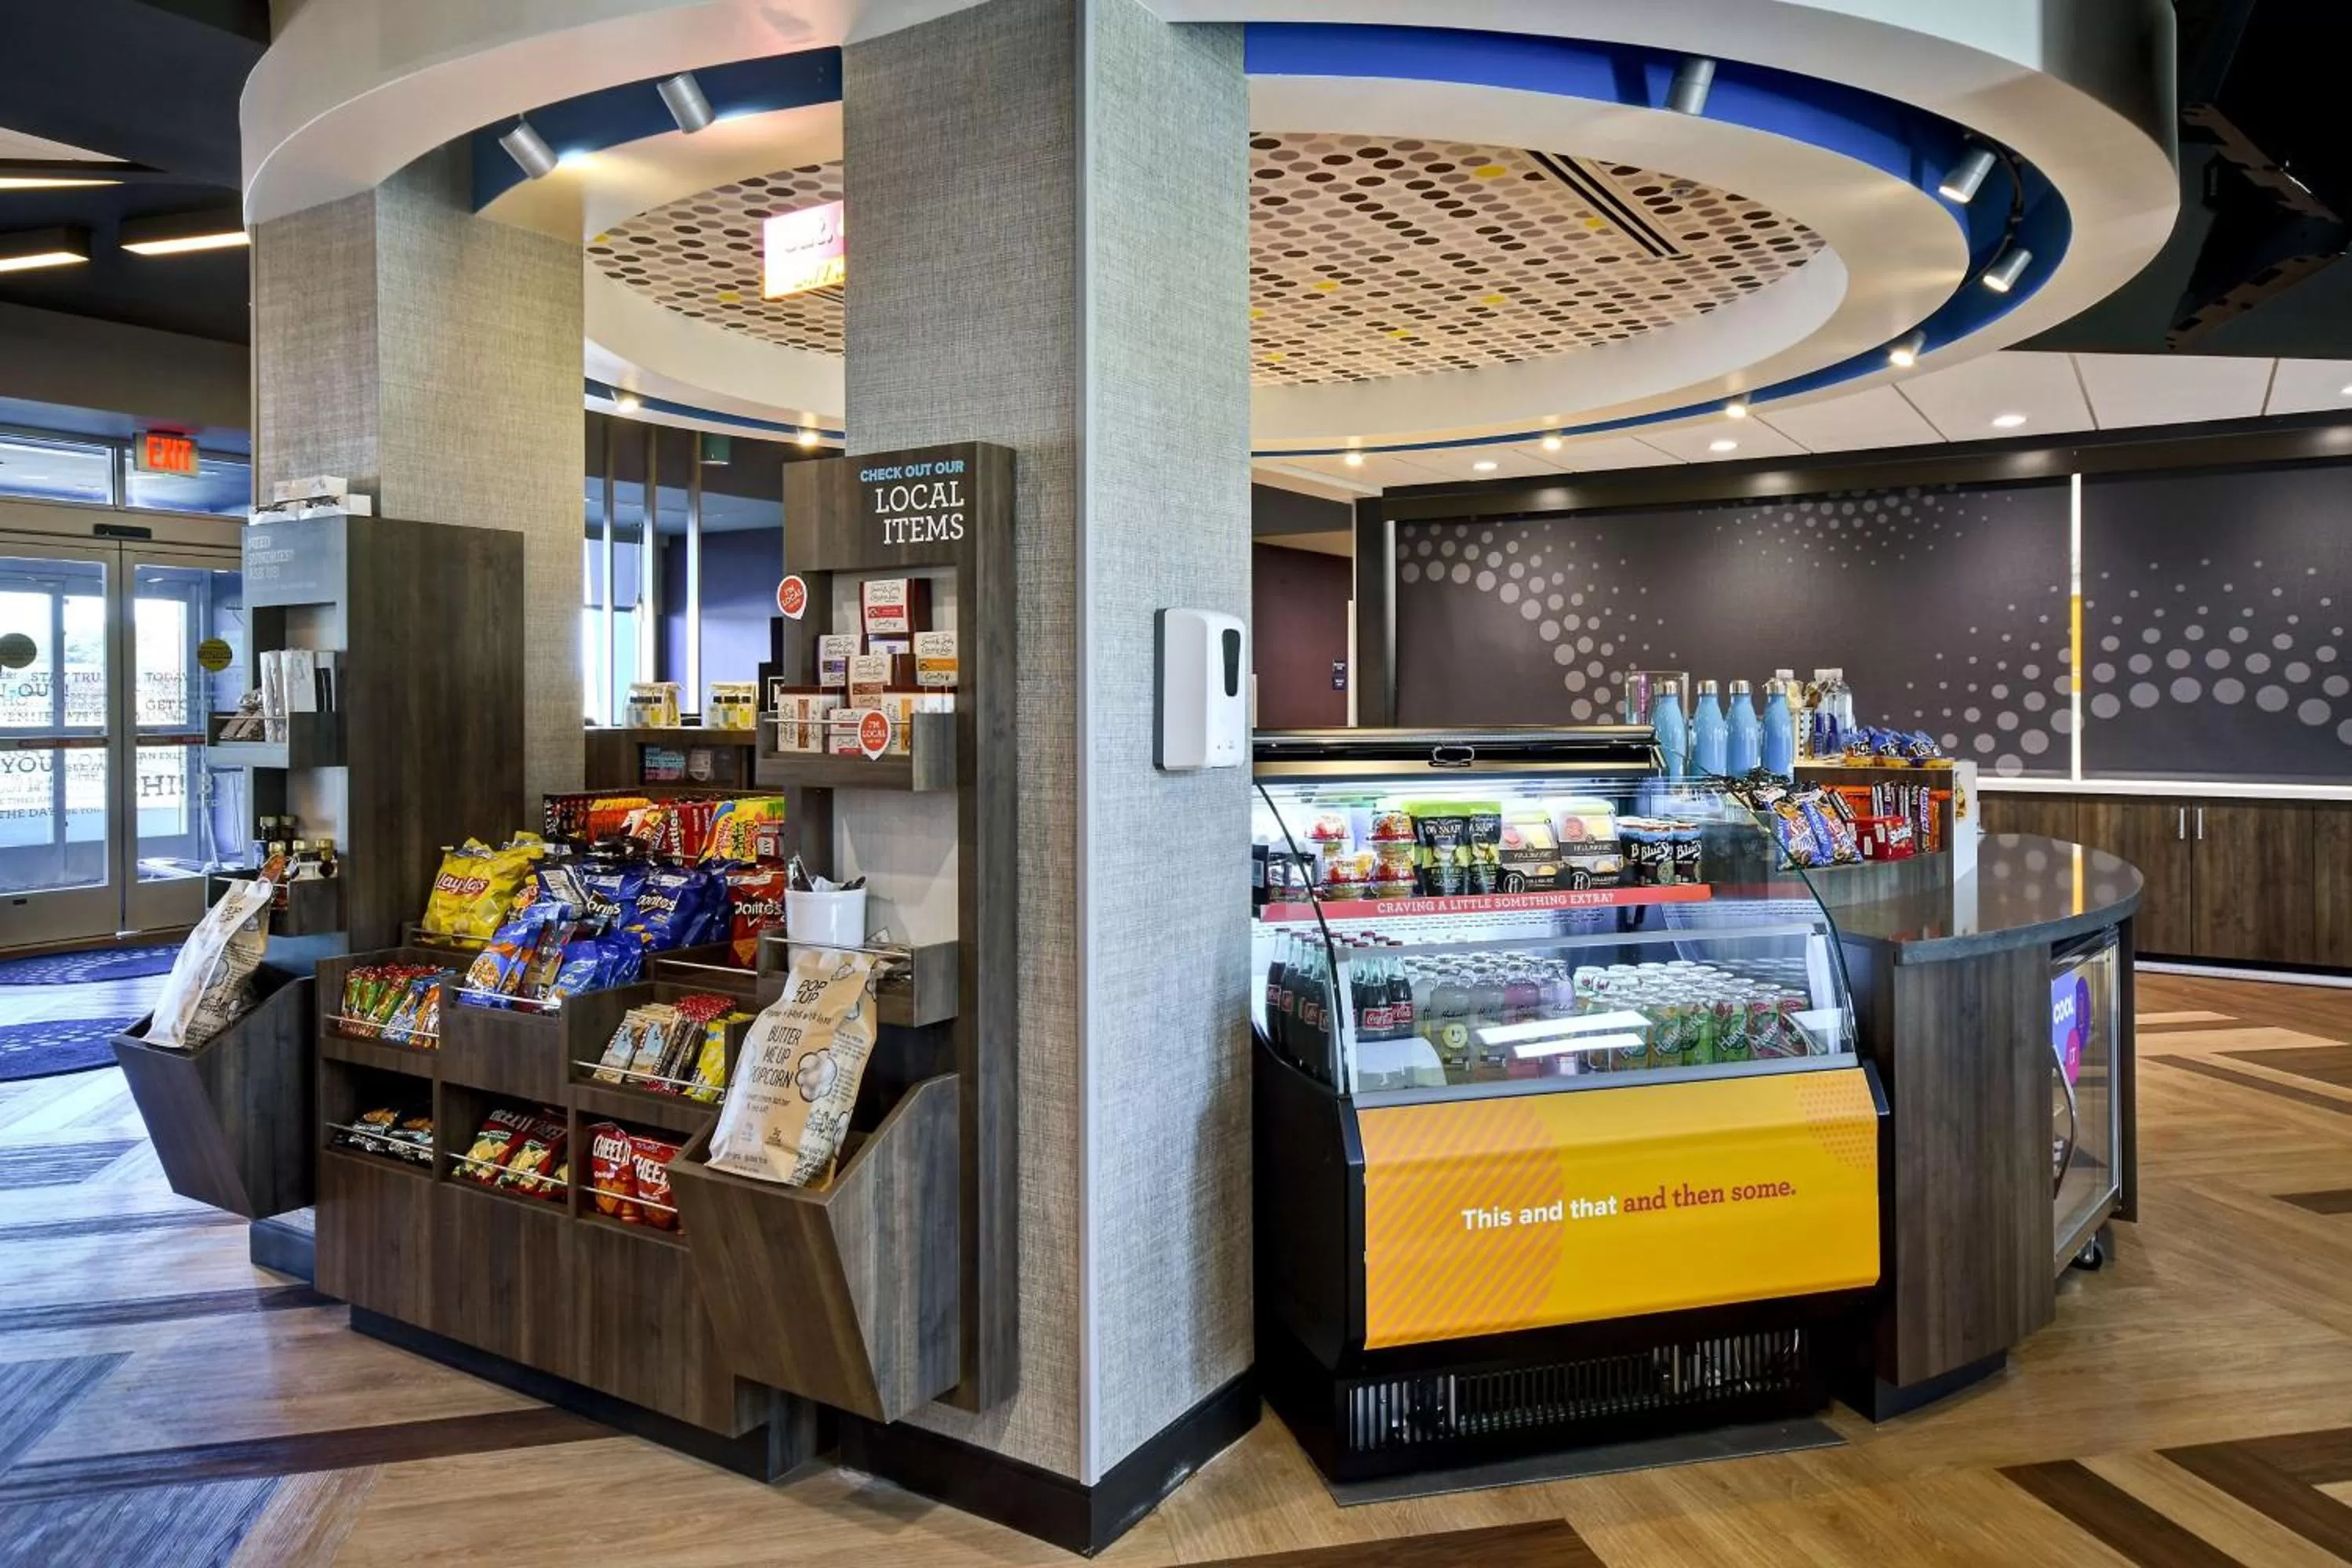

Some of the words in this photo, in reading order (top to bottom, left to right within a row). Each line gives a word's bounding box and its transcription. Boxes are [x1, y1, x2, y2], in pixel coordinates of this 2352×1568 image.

[147, 436, 191, 472] EXIT
[860, 466, 902, 482] CHECK
[906, 463, 932, 477] OUT
[935, 460, 964, 474] OUR
[875, 481, 965, 514] LOCAL
[884, 513, 964, 544] ITEMS
[2, 757, 53, 774] YOU
[1377, 901, 1435, 913] CRAVING
[1438, 901, 1447, 911] A
[1450, 898, 1491, 910] LITTLE
[1494, 894, 1566, 908] SOMETHING
[1570, 892, 1614, 904] EXTRA?
[798, 979, 828, 993] POP
[2053, 993, 2074, 1025] COOL
[767, 1025, 803, 1045] BUTTER
[777, 1047, 791, 1064] UP
[1461, 1208, 1512, 1231] This
[1519, 1200, 1564, 1225] and
[1569, 1196, 1619, 1219] that
[1623, 1185, 1668, 1213] and
[1671, 1183, 1726, 1208] then
[1730, 1181, 1796, 1201] some.
